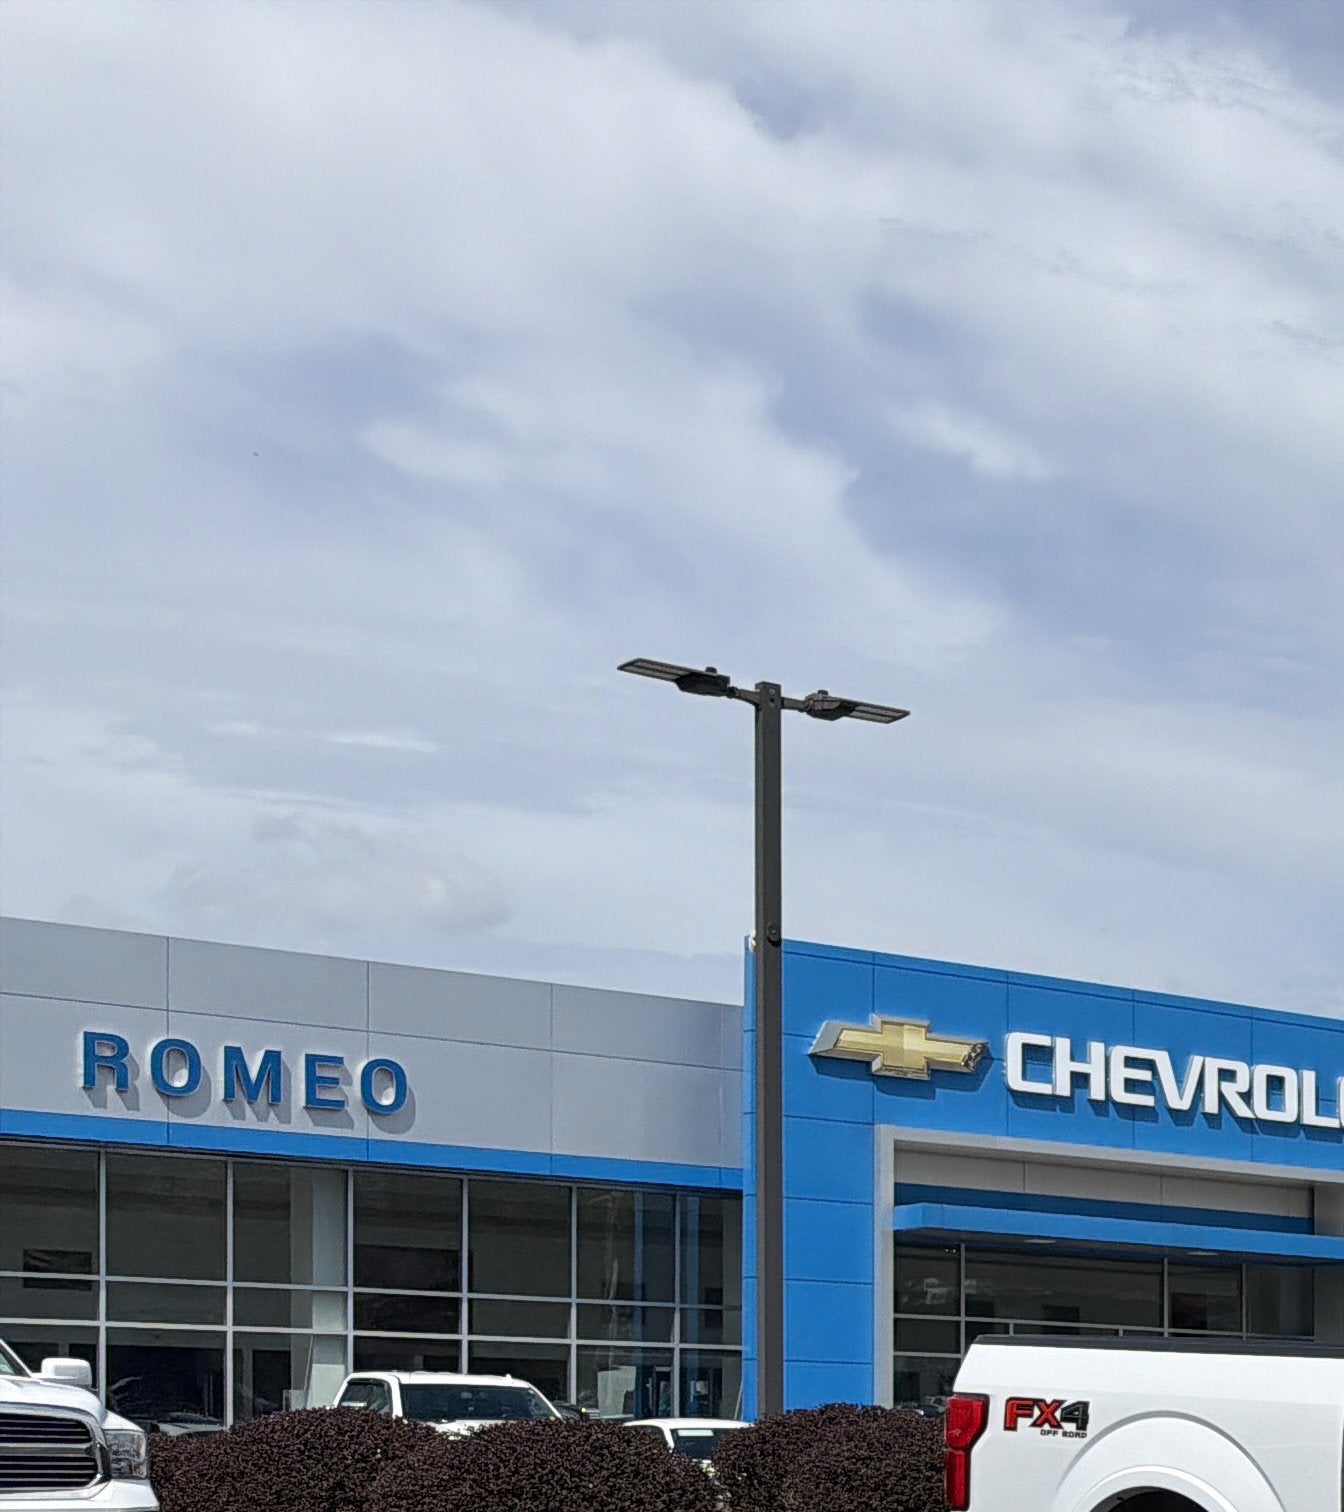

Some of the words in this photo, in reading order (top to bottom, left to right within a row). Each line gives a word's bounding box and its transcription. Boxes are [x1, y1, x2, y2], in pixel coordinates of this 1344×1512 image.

[81, 1030, 409, 1116] ROMEO
[1003, 1396, 1090, 1432] FX4
[1040, 1429, 1058, 1437] OFF
[1061, 1430, 1087, 1439] ROAD
